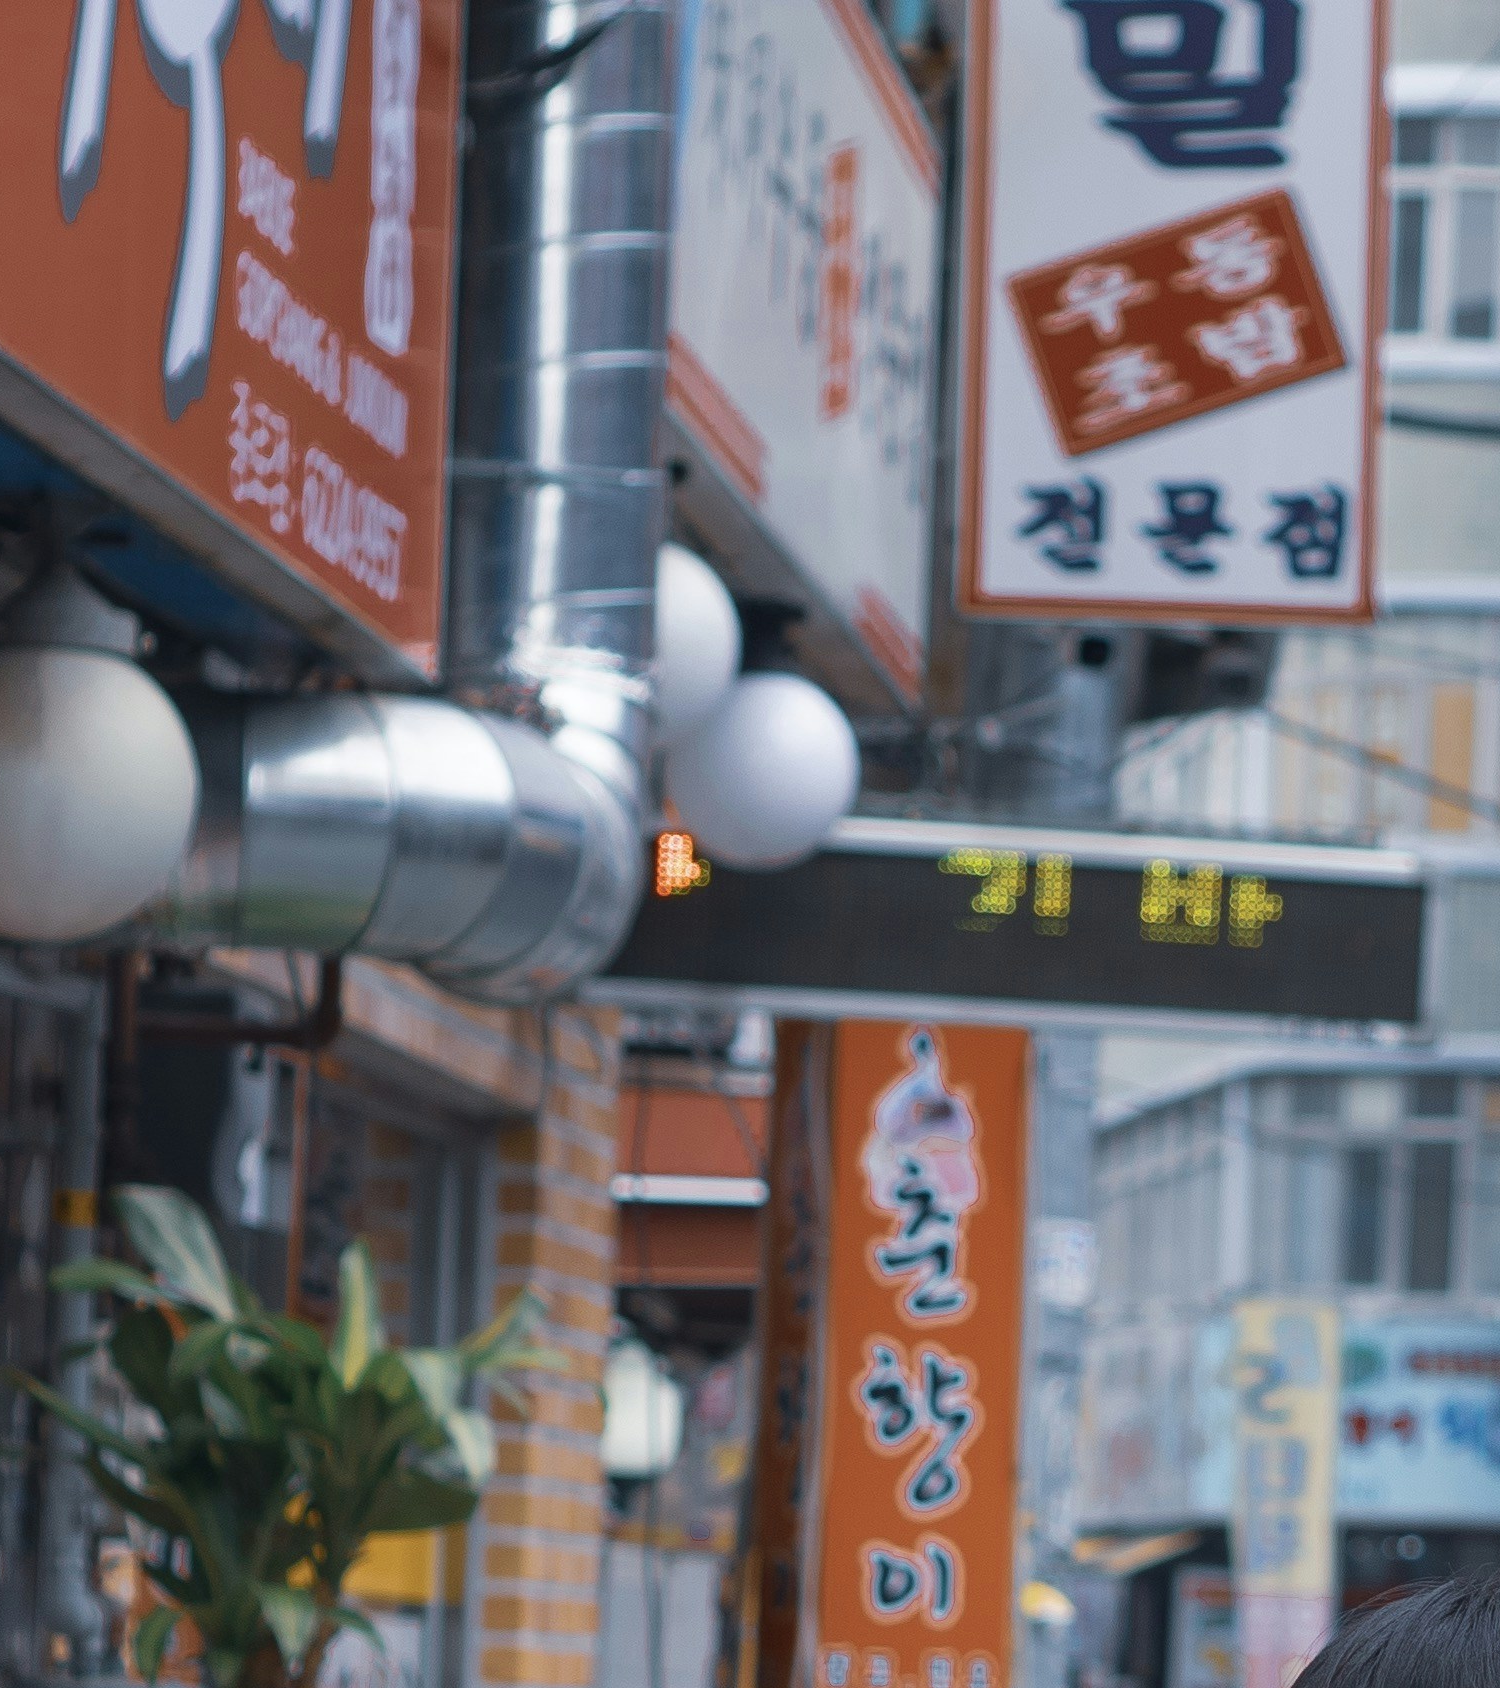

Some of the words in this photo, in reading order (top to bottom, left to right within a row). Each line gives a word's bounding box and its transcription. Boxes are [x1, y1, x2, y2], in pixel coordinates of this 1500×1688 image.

[1042, 216, 1282, 338] 우동
[1071, 302, 1304, 434] 초밥
[1018, 474, 1349, 583] 전문점
[864, 1157, 974, 1620] 춘향이
